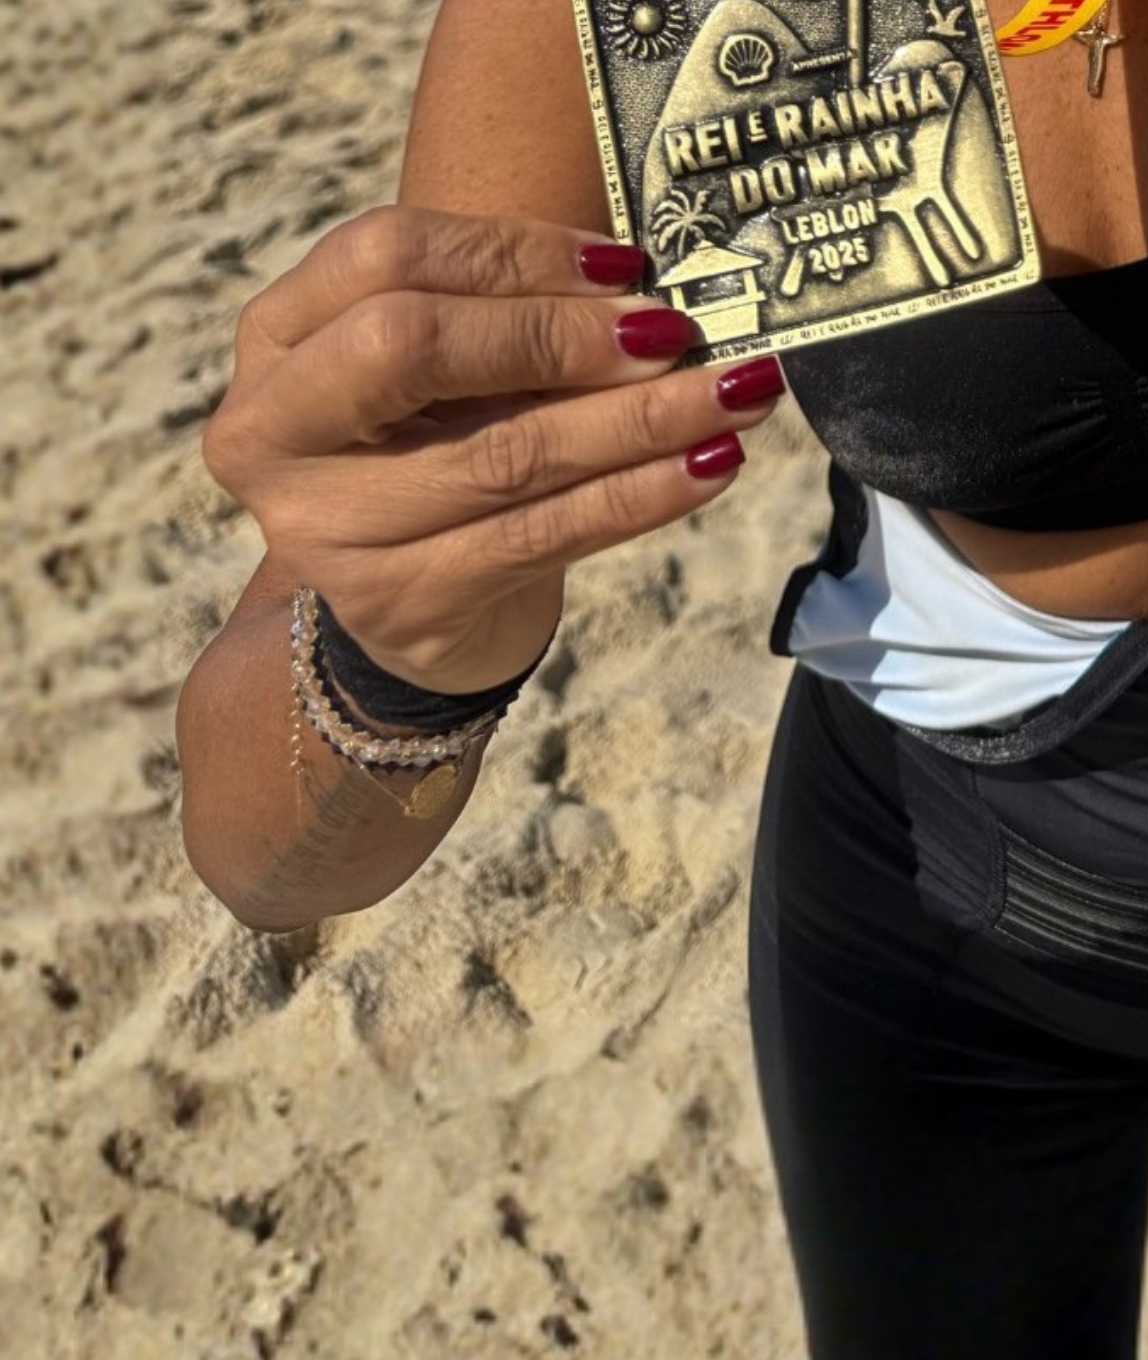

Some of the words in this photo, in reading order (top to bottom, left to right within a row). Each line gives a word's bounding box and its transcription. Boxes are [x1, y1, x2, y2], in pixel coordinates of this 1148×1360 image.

[664, 116, 743, 177] REI
[748, 110, 768, 143] E
[774, 70, 950, 150] RAINHA
[729, 156, 796, 214] DO
[805, 131, 909, 196] MAR
[782, 198, 878, 246] LEBLON
[808, 237, 871, 276] 2025
